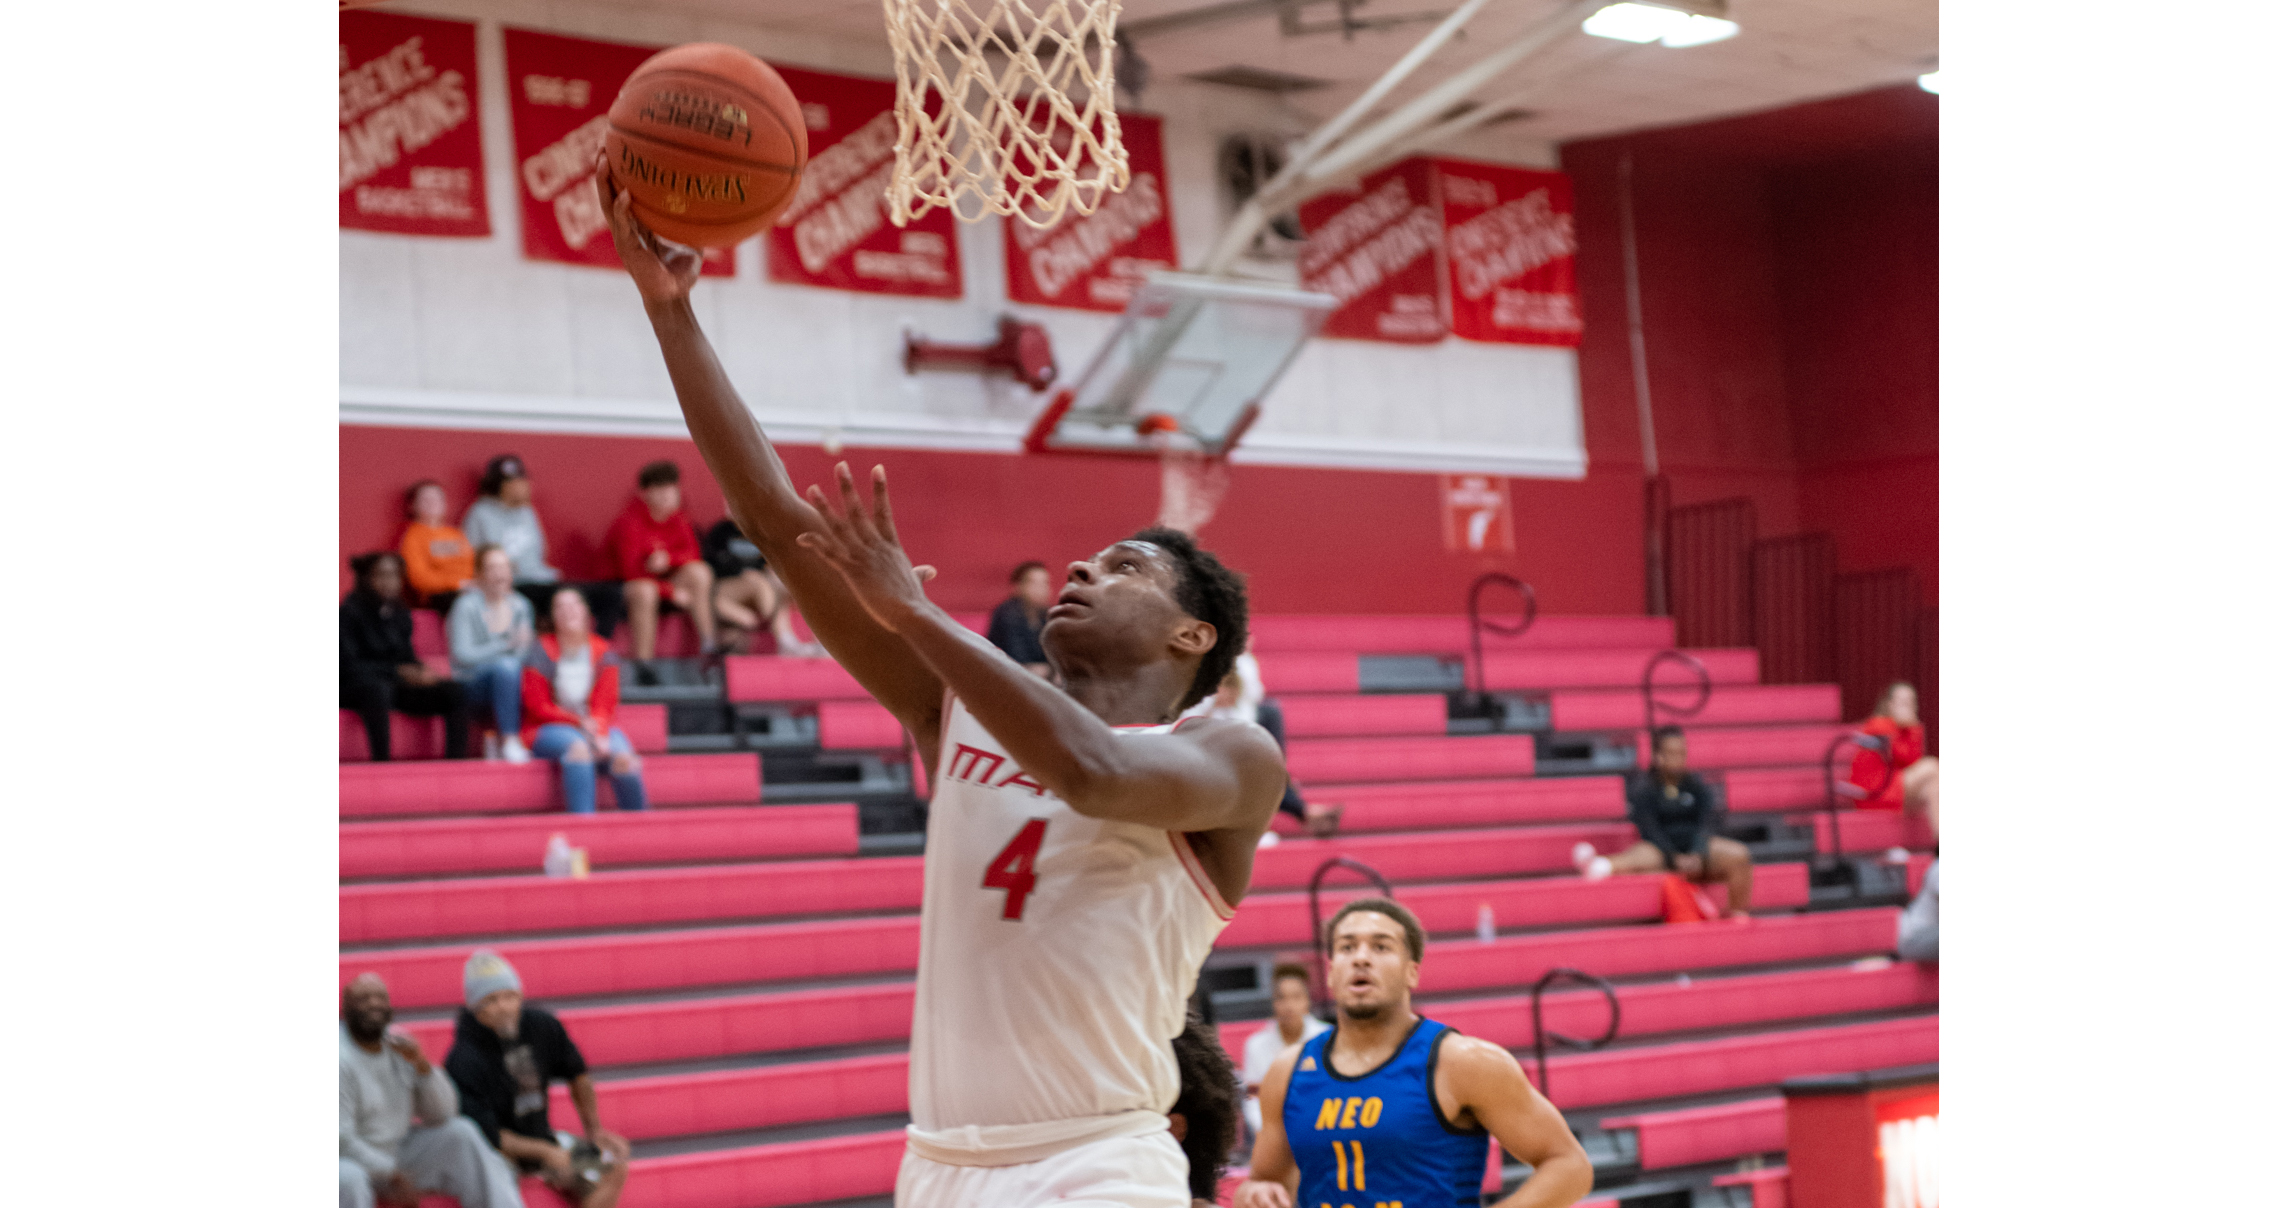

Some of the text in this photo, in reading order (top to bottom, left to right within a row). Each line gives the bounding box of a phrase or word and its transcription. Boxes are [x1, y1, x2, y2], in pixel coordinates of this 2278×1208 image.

[622, 142, 750, 203] SPALDING
[982, 817, 1049, 922] 4
[1315, 1096, 1383, 1131] NEO
[1332, 1140, 1366, 1192] 11
